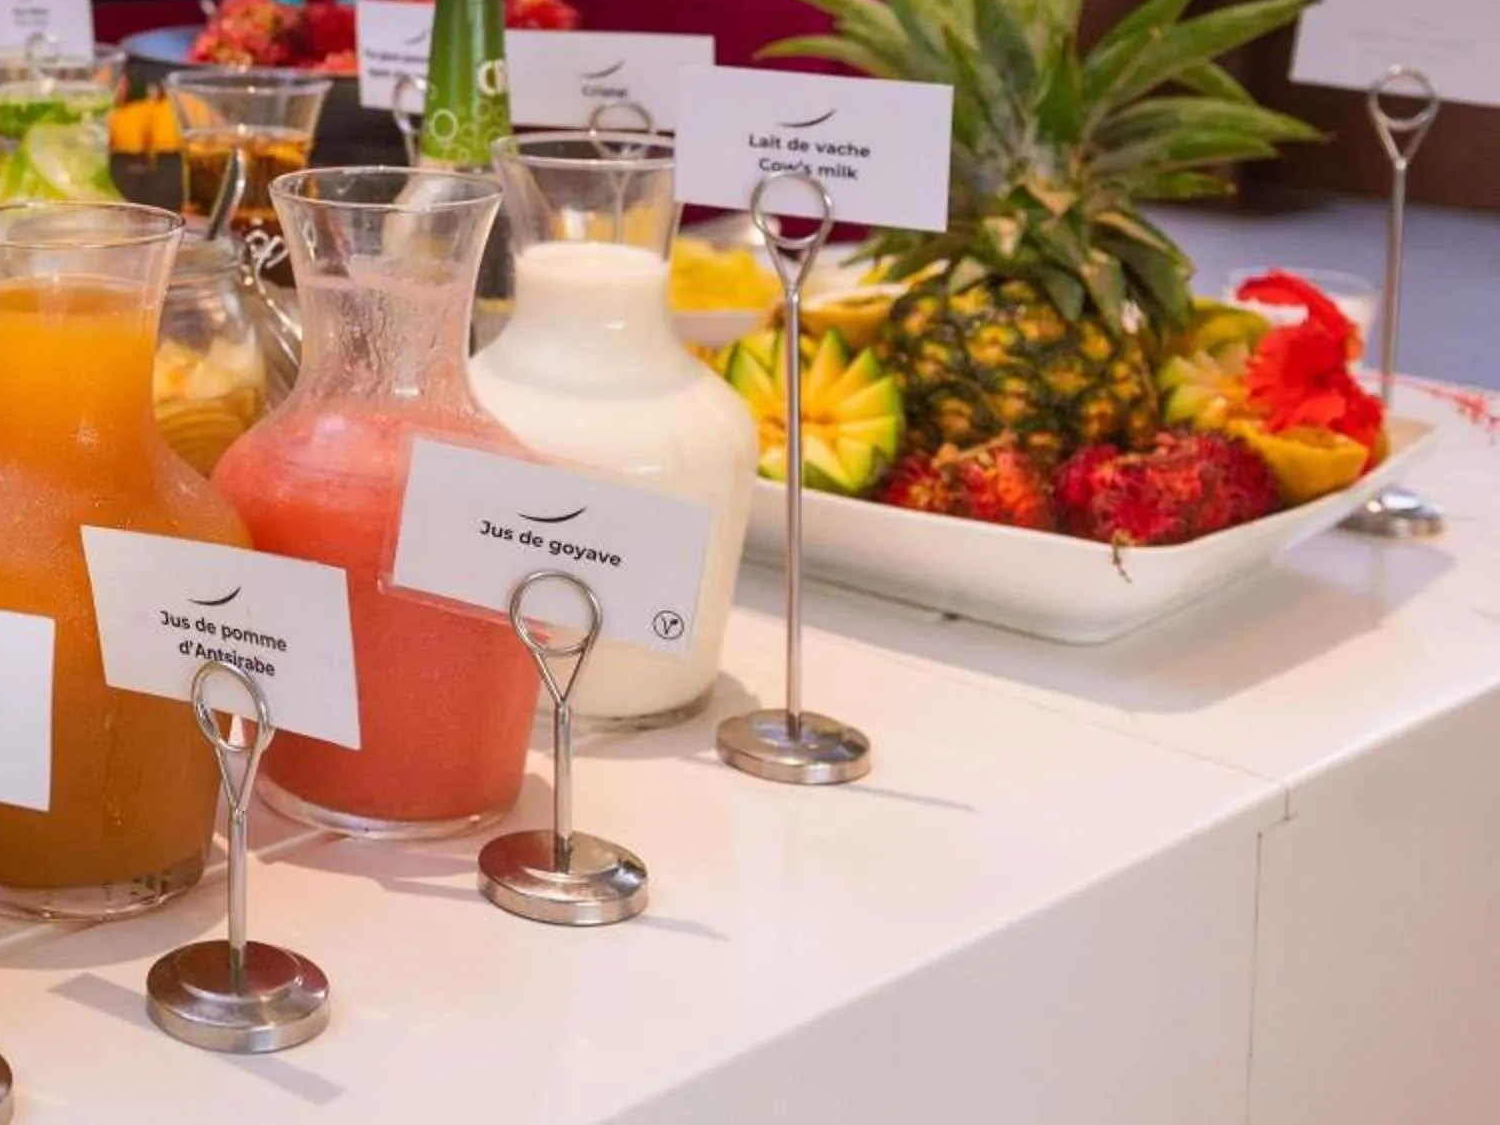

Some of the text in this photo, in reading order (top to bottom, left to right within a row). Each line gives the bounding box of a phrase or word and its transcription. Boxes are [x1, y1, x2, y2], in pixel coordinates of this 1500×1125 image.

[748, 132, 871, 158] Lait de vache
[758, 157, 858, 180] Cow's milk
[479, 520, 622, 566] Jus de goyave
[160, 610, 287, 651] Jus de pomme
[178, 640, 276, 677] d'Antsirabe
